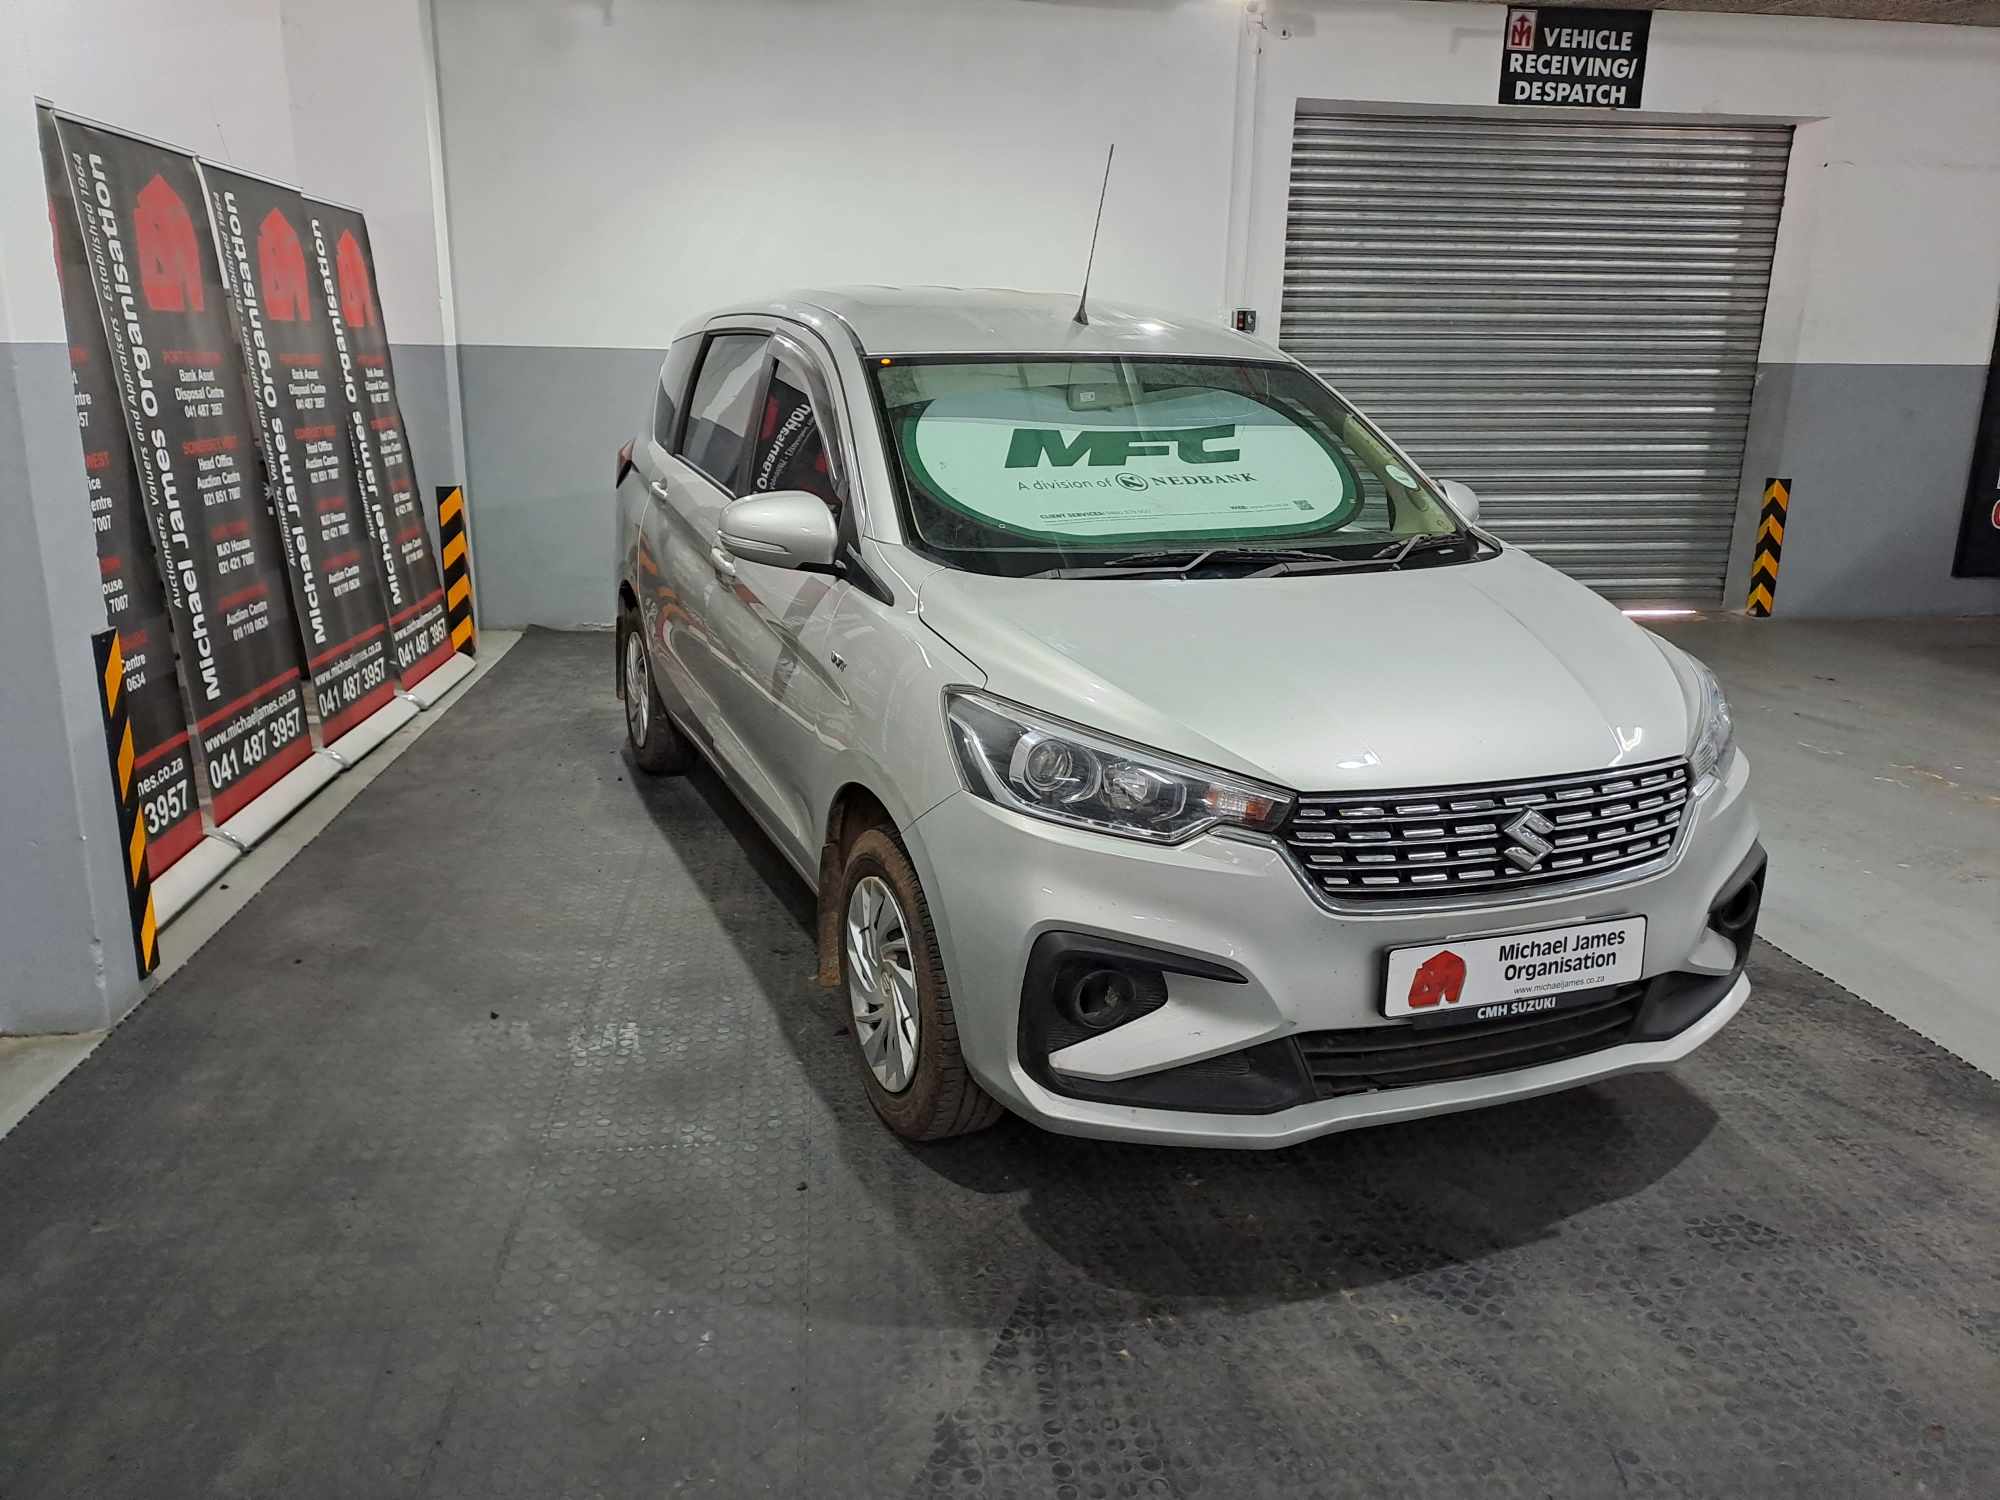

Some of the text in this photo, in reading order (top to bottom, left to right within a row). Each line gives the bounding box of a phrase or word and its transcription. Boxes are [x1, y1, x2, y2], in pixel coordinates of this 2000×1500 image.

[1544, 27, 1633, 51] VEHICLE
[1509, 53, 1638, 79] RECEIVING/
[1514, 80, 1627, 105] DESPATCH
[73, 152, 90, 196] 1964
[82, 200, 113, 301] Established
[312, 219, 357, 403] Organisation
[111, 317, 137, 406] Appraisers
[89, 154, 220, 700] Michael James Organisation
[130, 409, 144, 442] and
[224, 192, 326, 644] Michael James Organisation
[352, 412, 378, 496] James
[1004, 424, 1241, 469] MFC
[140, 446, 159, 506] Valuers
[1018, 472, 1258, 491] A division of NEDBANK
[90, 496, 112, 511] entre
[156, 512, 182, 608] Auctioneers,
[372, 504, 402, 605] Michael
[102, 578, 123, 595] ouse
[109, 594, 128, 614] 7007
[398, 618, 446, 668] 041 487 3957
[126, 672, 146, 692] 0634
[319, 657, 385, 717] 041 487 3957
[210, 707, 300, 788] 041 487 3957
[144, 779, 187, 834] 3957
[1499, 930, 1626, 962] Michael James
[1504, 951, 1617, 980] Organisation
[1477, 996, 1558, 1020] CMH SUZUKI
